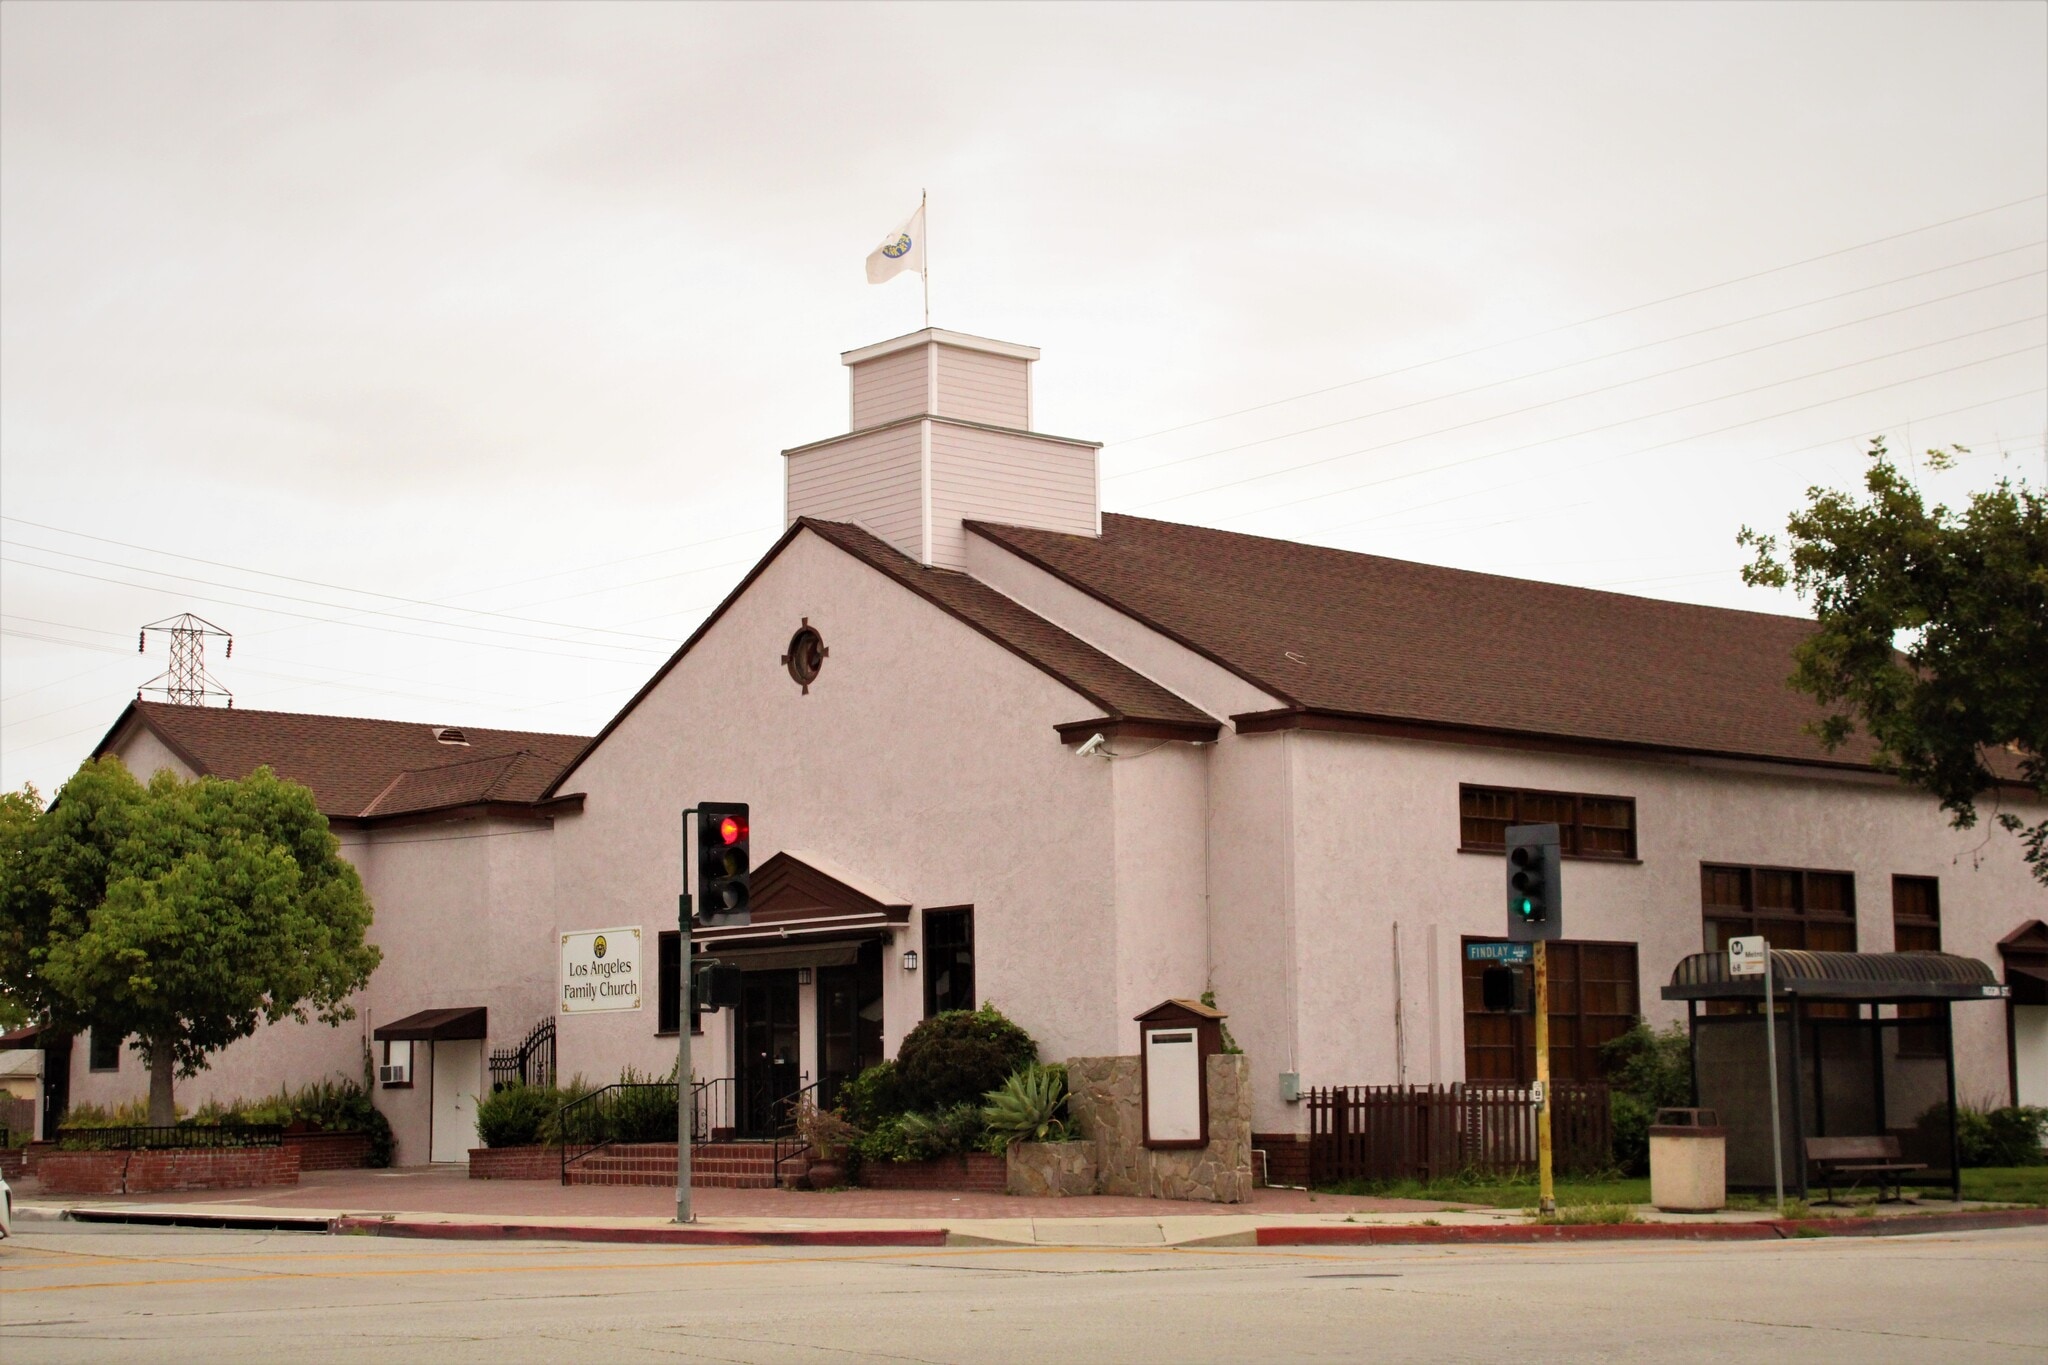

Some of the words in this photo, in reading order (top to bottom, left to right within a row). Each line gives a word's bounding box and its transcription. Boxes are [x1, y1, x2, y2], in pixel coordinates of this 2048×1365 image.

[1471, 946, 1508, 958] FINDLAY
[569, 962, 588, 977] Los
[590, 958, 632, 978] Angeles
[564, 982, 596, 1001] Family
[599, 980, 637, 997] Church
